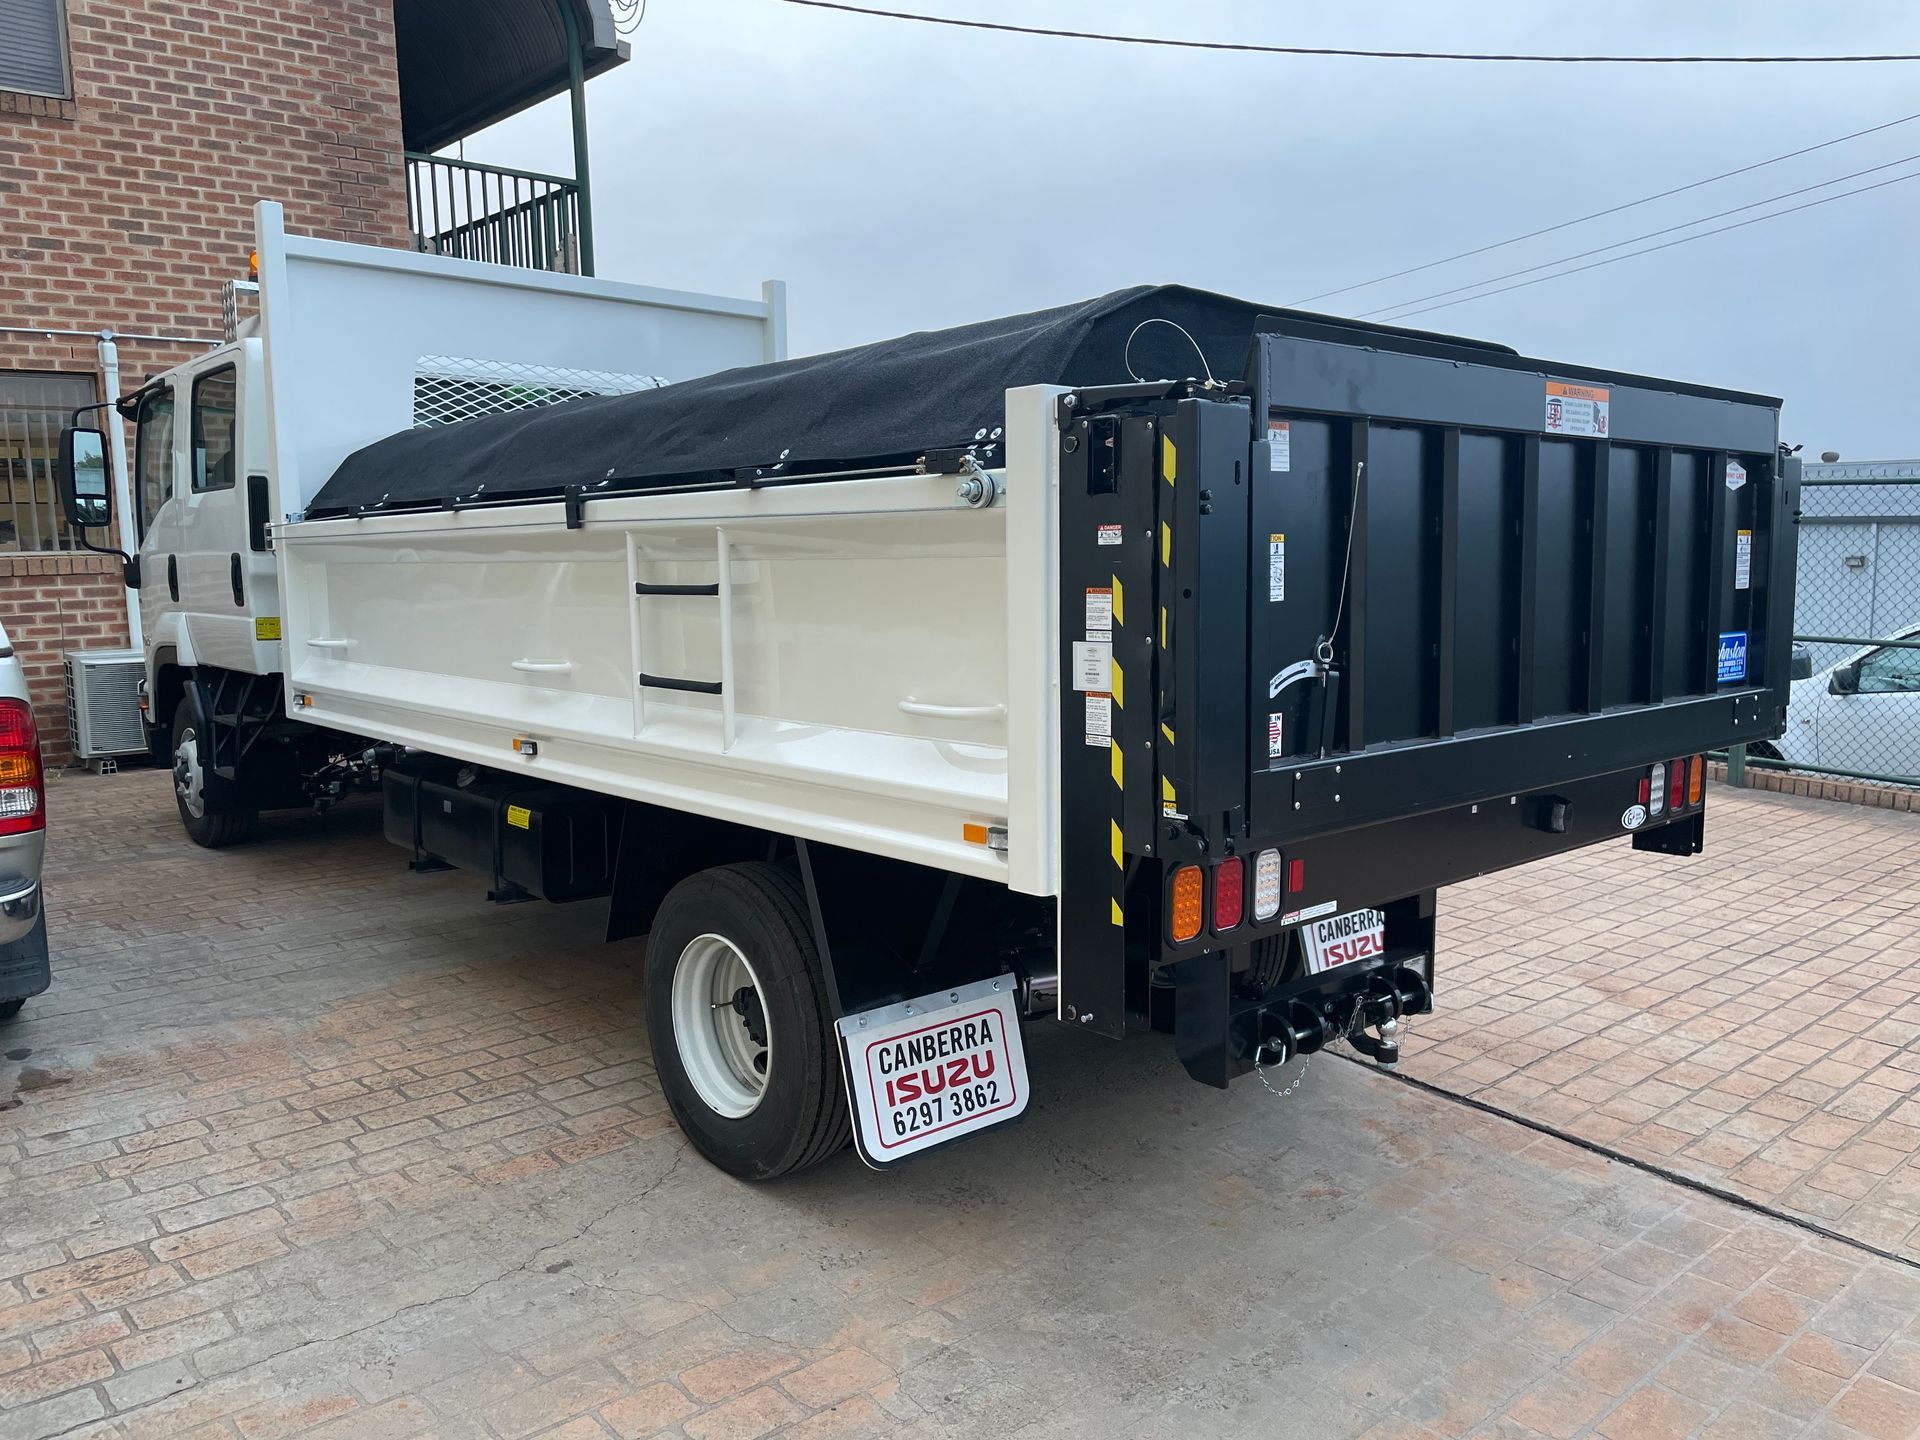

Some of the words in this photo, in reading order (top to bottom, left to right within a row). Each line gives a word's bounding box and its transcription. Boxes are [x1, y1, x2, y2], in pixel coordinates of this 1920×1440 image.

[1568, 387, 1594, 398] WARNING
[1719, 641, 1745, 660] hnston
[1318, 910, 1384, 943] CANBERRA
[1323, 931, 1384, 967] ISUZU
[878, 1018, 993, 1074] CANBERRA
[885, 1050, 995, 1107] ISUZU
[893, 1097, 943, 1136] 6297
[950, 1080, 1000, 1117] 3862
